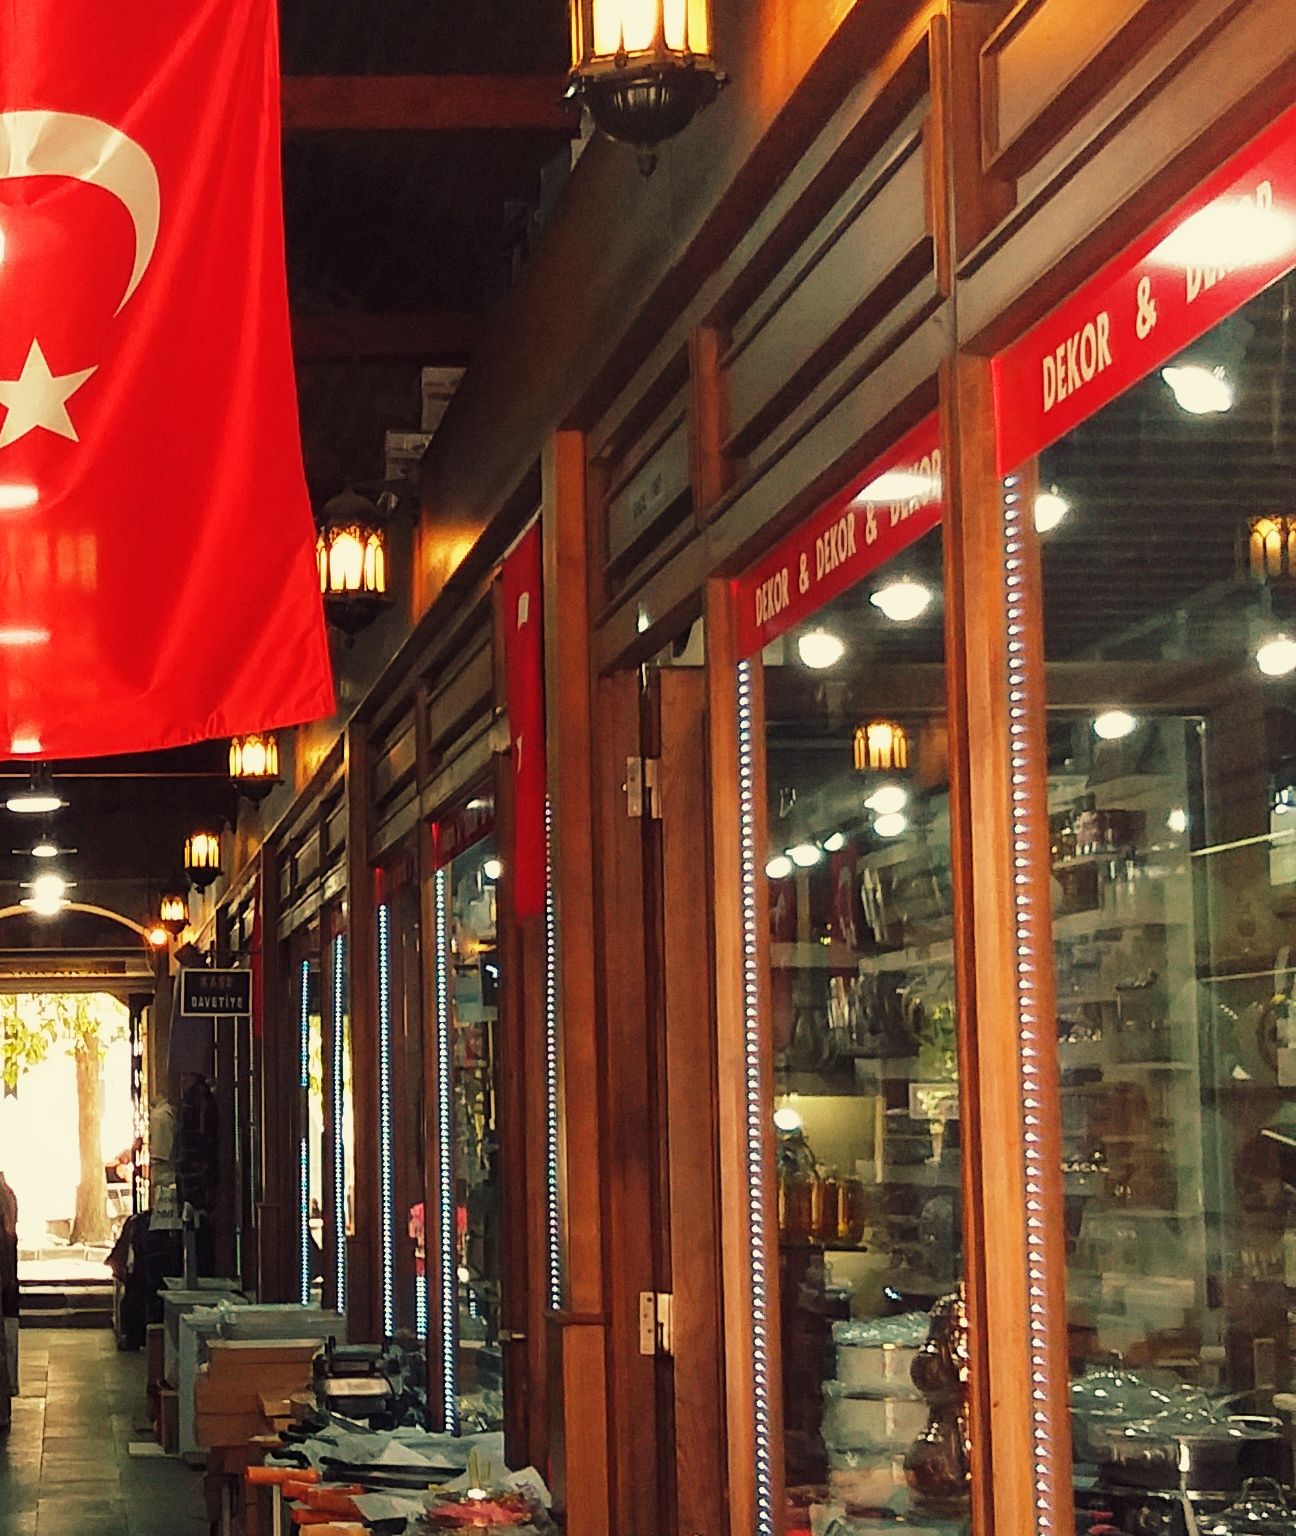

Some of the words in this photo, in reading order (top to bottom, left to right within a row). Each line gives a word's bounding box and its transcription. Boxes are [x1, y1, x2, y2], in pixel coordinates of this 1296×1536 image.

[1042, 311, 1112, 413] DEKOR
[1136, 275, 1157, 340] &
[756, 567, 790, 627] DEKOR
[799, 552, 810, 594] &
[816, 512, 856, 581] DEKOR
